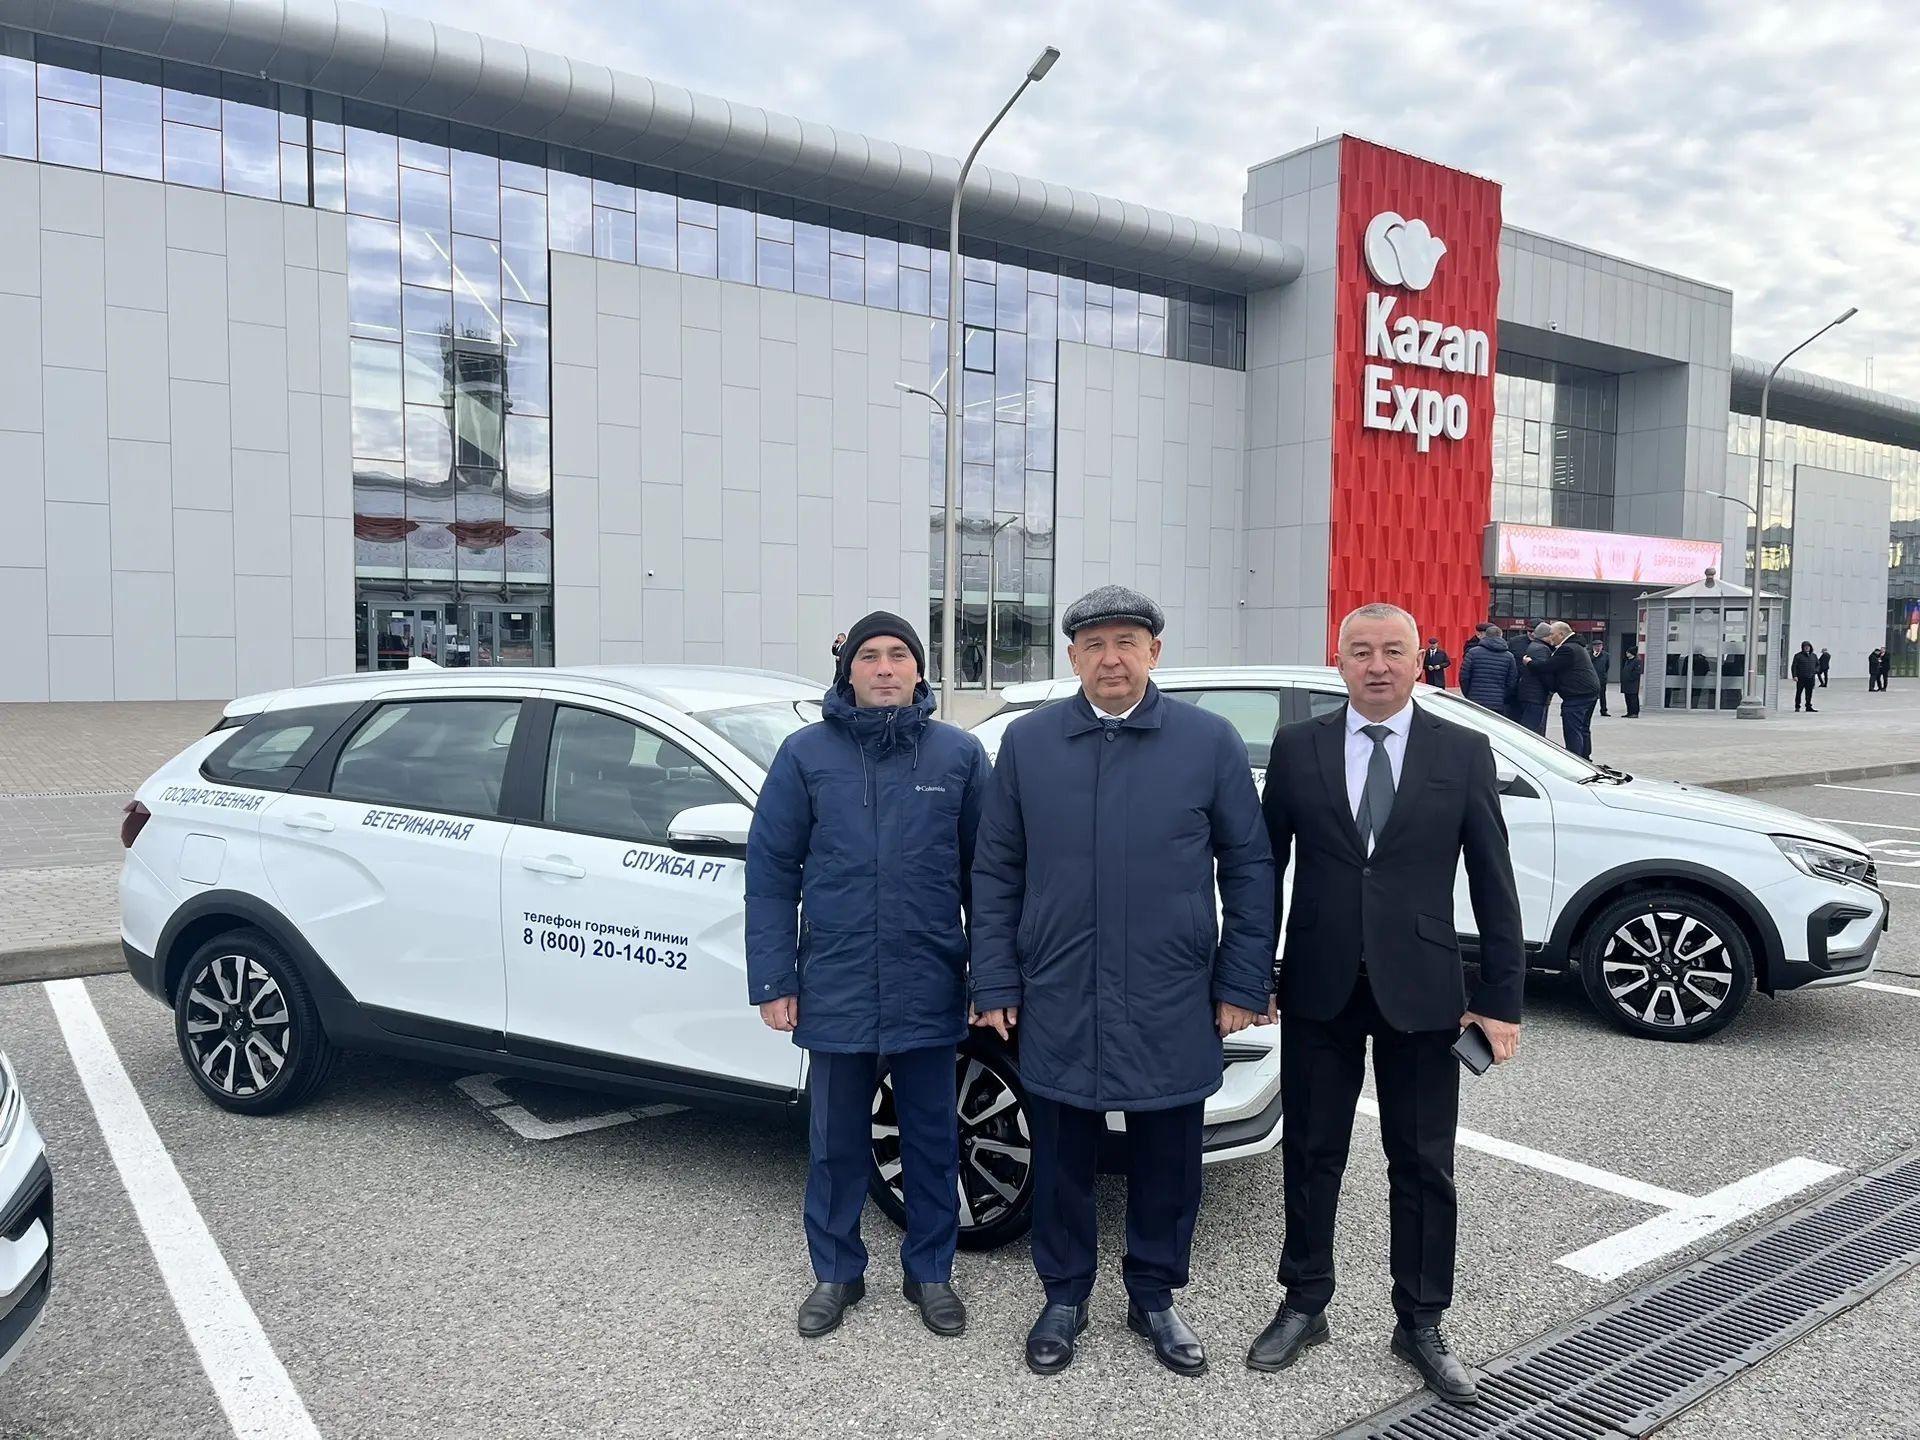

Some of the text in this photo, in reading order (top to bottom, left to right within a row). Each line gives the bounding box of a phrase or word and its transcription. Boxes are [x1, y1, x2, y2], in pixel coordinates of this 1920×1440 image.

[1365, 291, 1490, 377] Kazan
[1363, 364, 1468, 453] Expo
[159, 786, 266, 811] ГОСУДАРСТВЕННАЯ
[361, 809, 475, 841] ВЕТЕРИНАРНАЯ
[622, 849, 726, 882] СЛУЖБА РТ
[523, 911, 688, 946] телефон горячей линии
[523, 927, 687, 970] 8 (800) 20-140-32
